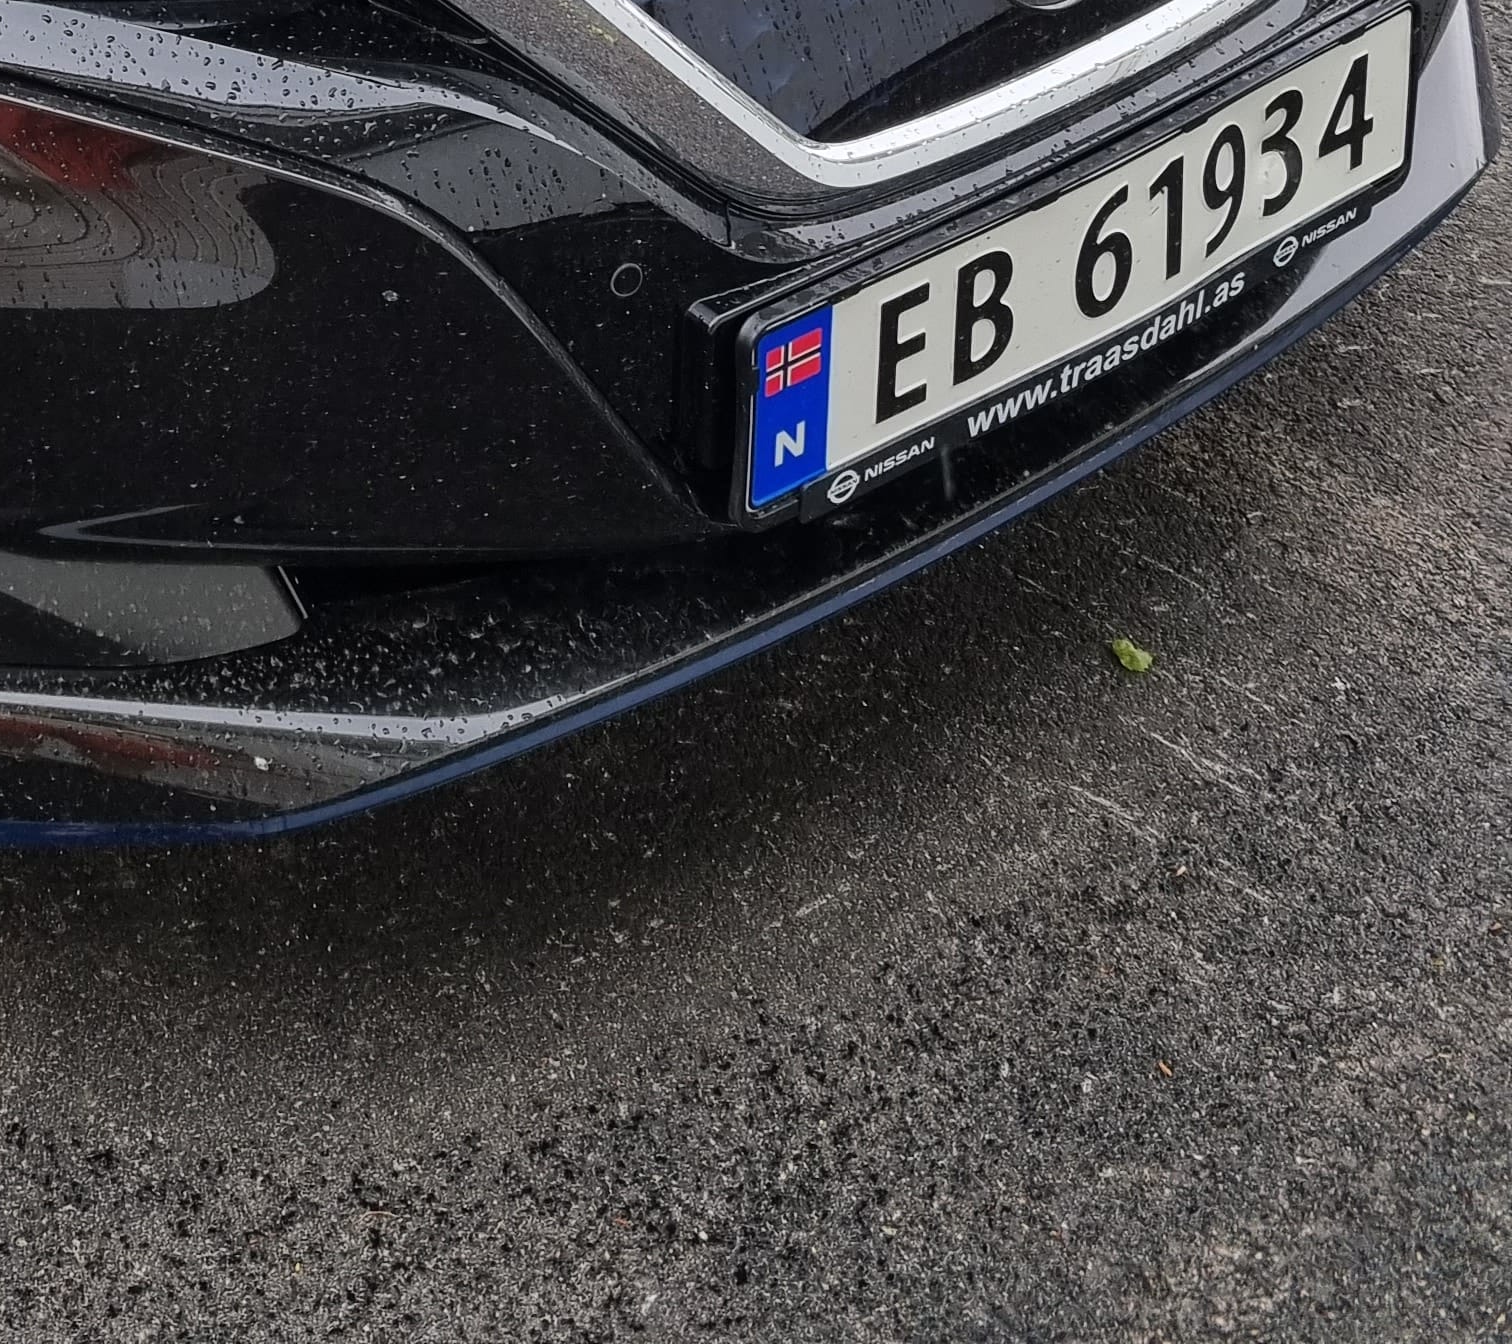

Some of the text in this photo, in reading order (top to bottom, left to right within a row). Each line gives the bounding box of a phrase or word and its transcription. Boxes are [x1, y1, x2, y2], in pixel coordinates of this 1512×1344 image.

[875, 53, 1374, 425] EB 61934
[1301, 207, 1357, 247] NISSAN
[967, 271, 1246, 438] www.traasdahl.as
[774, 420, 806, 468] N
[864, 436, 935, 481] NISSAN
